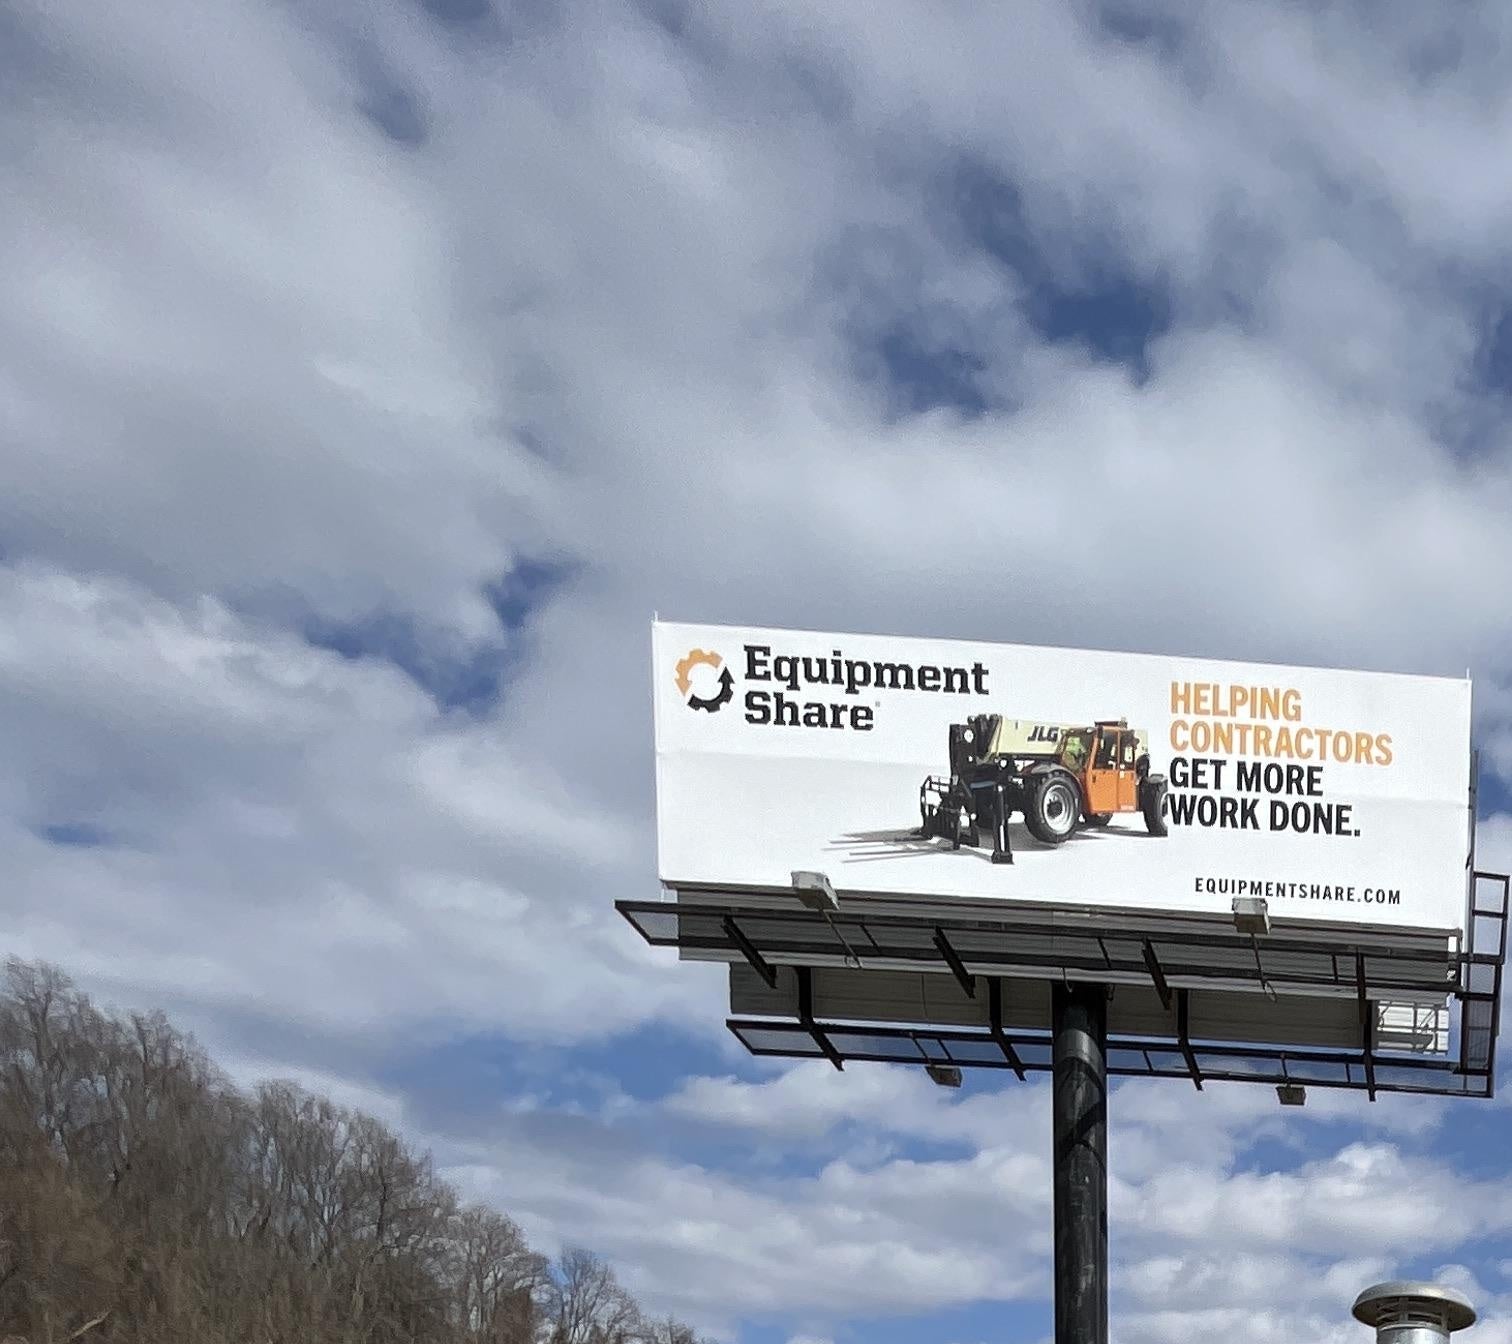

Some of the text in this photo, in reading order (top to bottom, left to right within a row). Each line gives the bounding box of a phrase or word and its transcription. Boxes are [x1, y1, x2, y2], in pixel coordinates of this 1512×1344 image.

[743, 645, 989, 695] Equipment
[744, 691, 874, 731] Share
[1170, 681, 1302, 722] HELPING
[1027, 725, 1060, 743] JLG
[1169, 720, 1394, 766] CONTRACTORS
[1169, 756, 1324, 797] GET MORE
[1167, 793, 1362, 837] WORK DONE.
[1194, 877, 1402, 905] EQUIPMENTSHARE.COM
